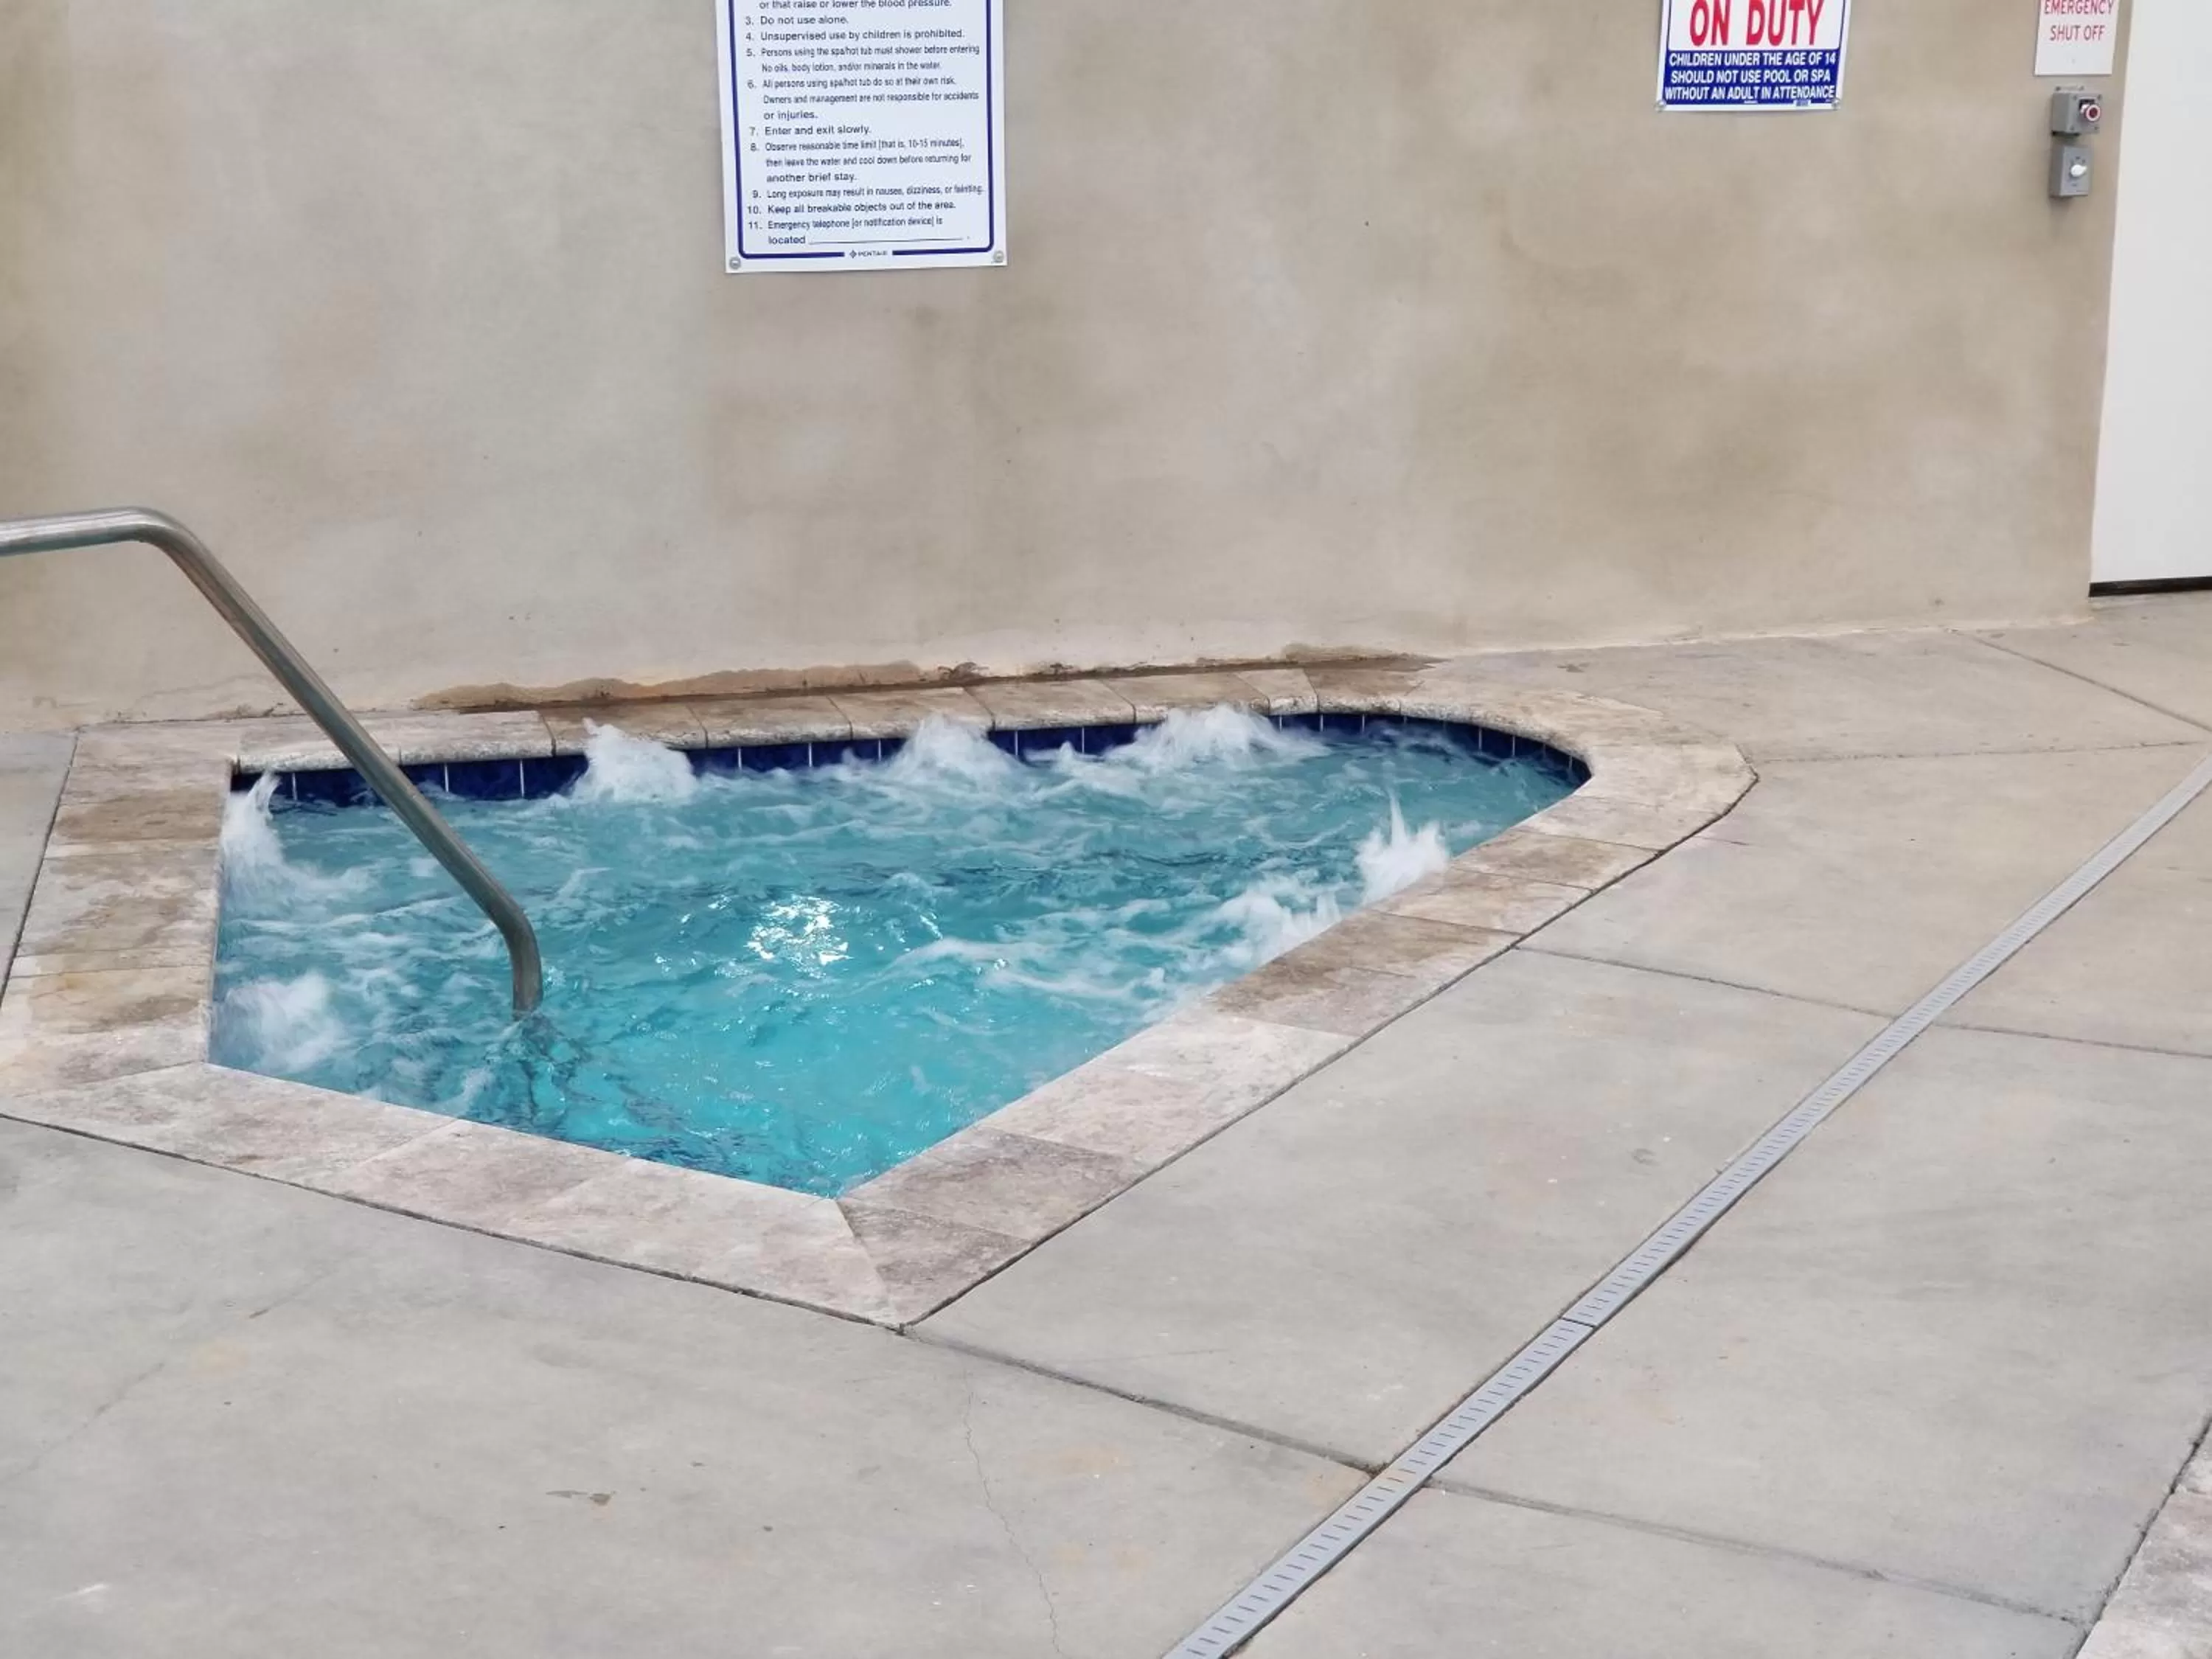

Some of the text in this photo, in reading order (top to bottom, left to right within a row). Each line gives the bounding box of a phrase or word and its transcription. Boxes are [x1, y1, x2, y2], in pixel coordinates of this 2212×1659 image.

[773, 1, 790, 9] that
[832, 0, 858, 8] lower
[908, 0, 952, 8] pressure.
[2045, 0, 2114, 14] EMERGENCY
[760, 15, 774, 24] Do
[818, 15, 848, 24] alone.
[1689, 0, 1825, 46] ON DUTY
[761, 31, 827, 42] Unsupervised
[849, 31, 860, 41] by
[863, 30, 901, 38] children
[904, 29, 911, 38] is
[914, 29, 964, 39] prohibited.
[2050, 25, 2105, 41] SHUT OFF
[762, 48, 792, 57] Persons
[795, 47, 814, 58] using
[817, 47, 829, 55] the
[895, 46, 922, 54] shower
[925, 45, 947, 53] before
[907, 61, 919, 69] the
[1669, 52, 1835, 66] CHILDREN UNDER THE AGE OF 14
[1671, 69, 1830, 83] SHOULD NOT USE POOL OR SPA
[774, 80, 804, 89] persons
[807, 80, 827, 89] using
[764, 95, 792, 104] Owners
[794, 95, 807, 103] and
[810, 94, 858, 105] management
[873, 94, 886, 102] not
[887, 92, 930, 102] responsible
[1665, 86, 1834, 100] WITHOUT AN ADULT IN ATTENDANCE
[764, 111, 818, 121] or injuries.
[765, 127, 792, 136] Enter
[795, 127, 813, 135] and
[817, 125, 834, 134] exit
[838, 125, 871, 135] slowly.
[765, 142, 796, 150] Observe
[799, 142, 841, 150] reasonable
[843, 140, 858, 149] time
[767, 159, 782, 167] then
[785, 158, 804, 166] leave
[844, 156, 857, 164] and
[859, 156, 875, 164] cool
[877, 156, 897, 164] down
[900, 155, 923, 163] before
[925, 155, 959, 164] returning
[961, 153, 972, 162] for
[767, 173, 858, 182] another brief stay.
[768, 190, 786, 198] Long
[789, 189, 824, 199] exposure
[826, 189, 841, 198] may
[844, 188, 864, 196] result
[867, 187, 873, 195] in
[768, 205, 791, 215] Keep
[794, 204, 804, 212] all
[808, 204, 851, 212] breakable
[855, 204, 886, 215] objects
[890, 201, 905, 210] out
[907, 201, 916, 209] of
[918, 201, 932, 209] the
[768, 220, 810, 230] Emergency
[813, 220, 849, 230] telephone
[864, 217, 905, 226] notification
[936, 215, 942, 225] is
[768, 236, 806, 245] located
